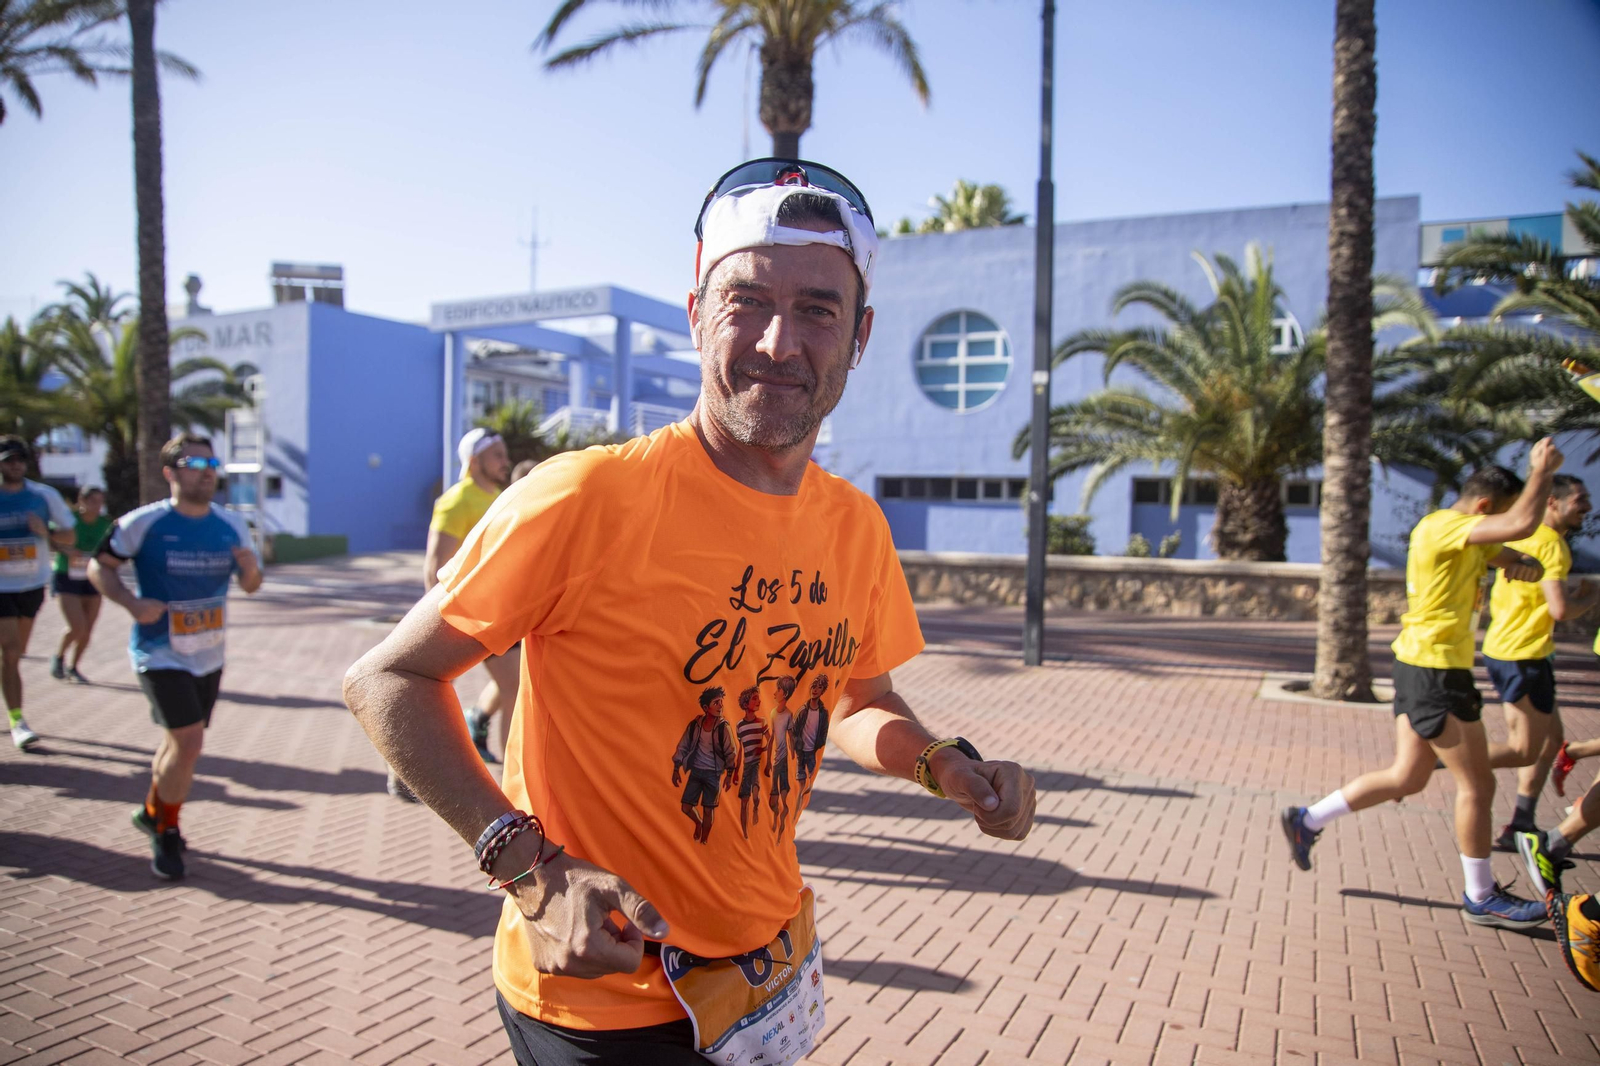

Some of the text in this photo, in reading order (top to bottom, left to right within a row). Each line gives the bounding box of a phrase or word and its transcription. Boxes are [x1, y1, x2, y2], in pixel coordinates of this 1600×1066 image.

[443, 299, 515, 321] EDIFICIO
[214, 321, 275, 348] MAR
[729, 565, 828, 613] Los 5 de
[683, 617, 860, 688] El Zapillo
[765, 964, 793, 993] VICTOR
[762, 1020, 786, 1046] NEXAL
